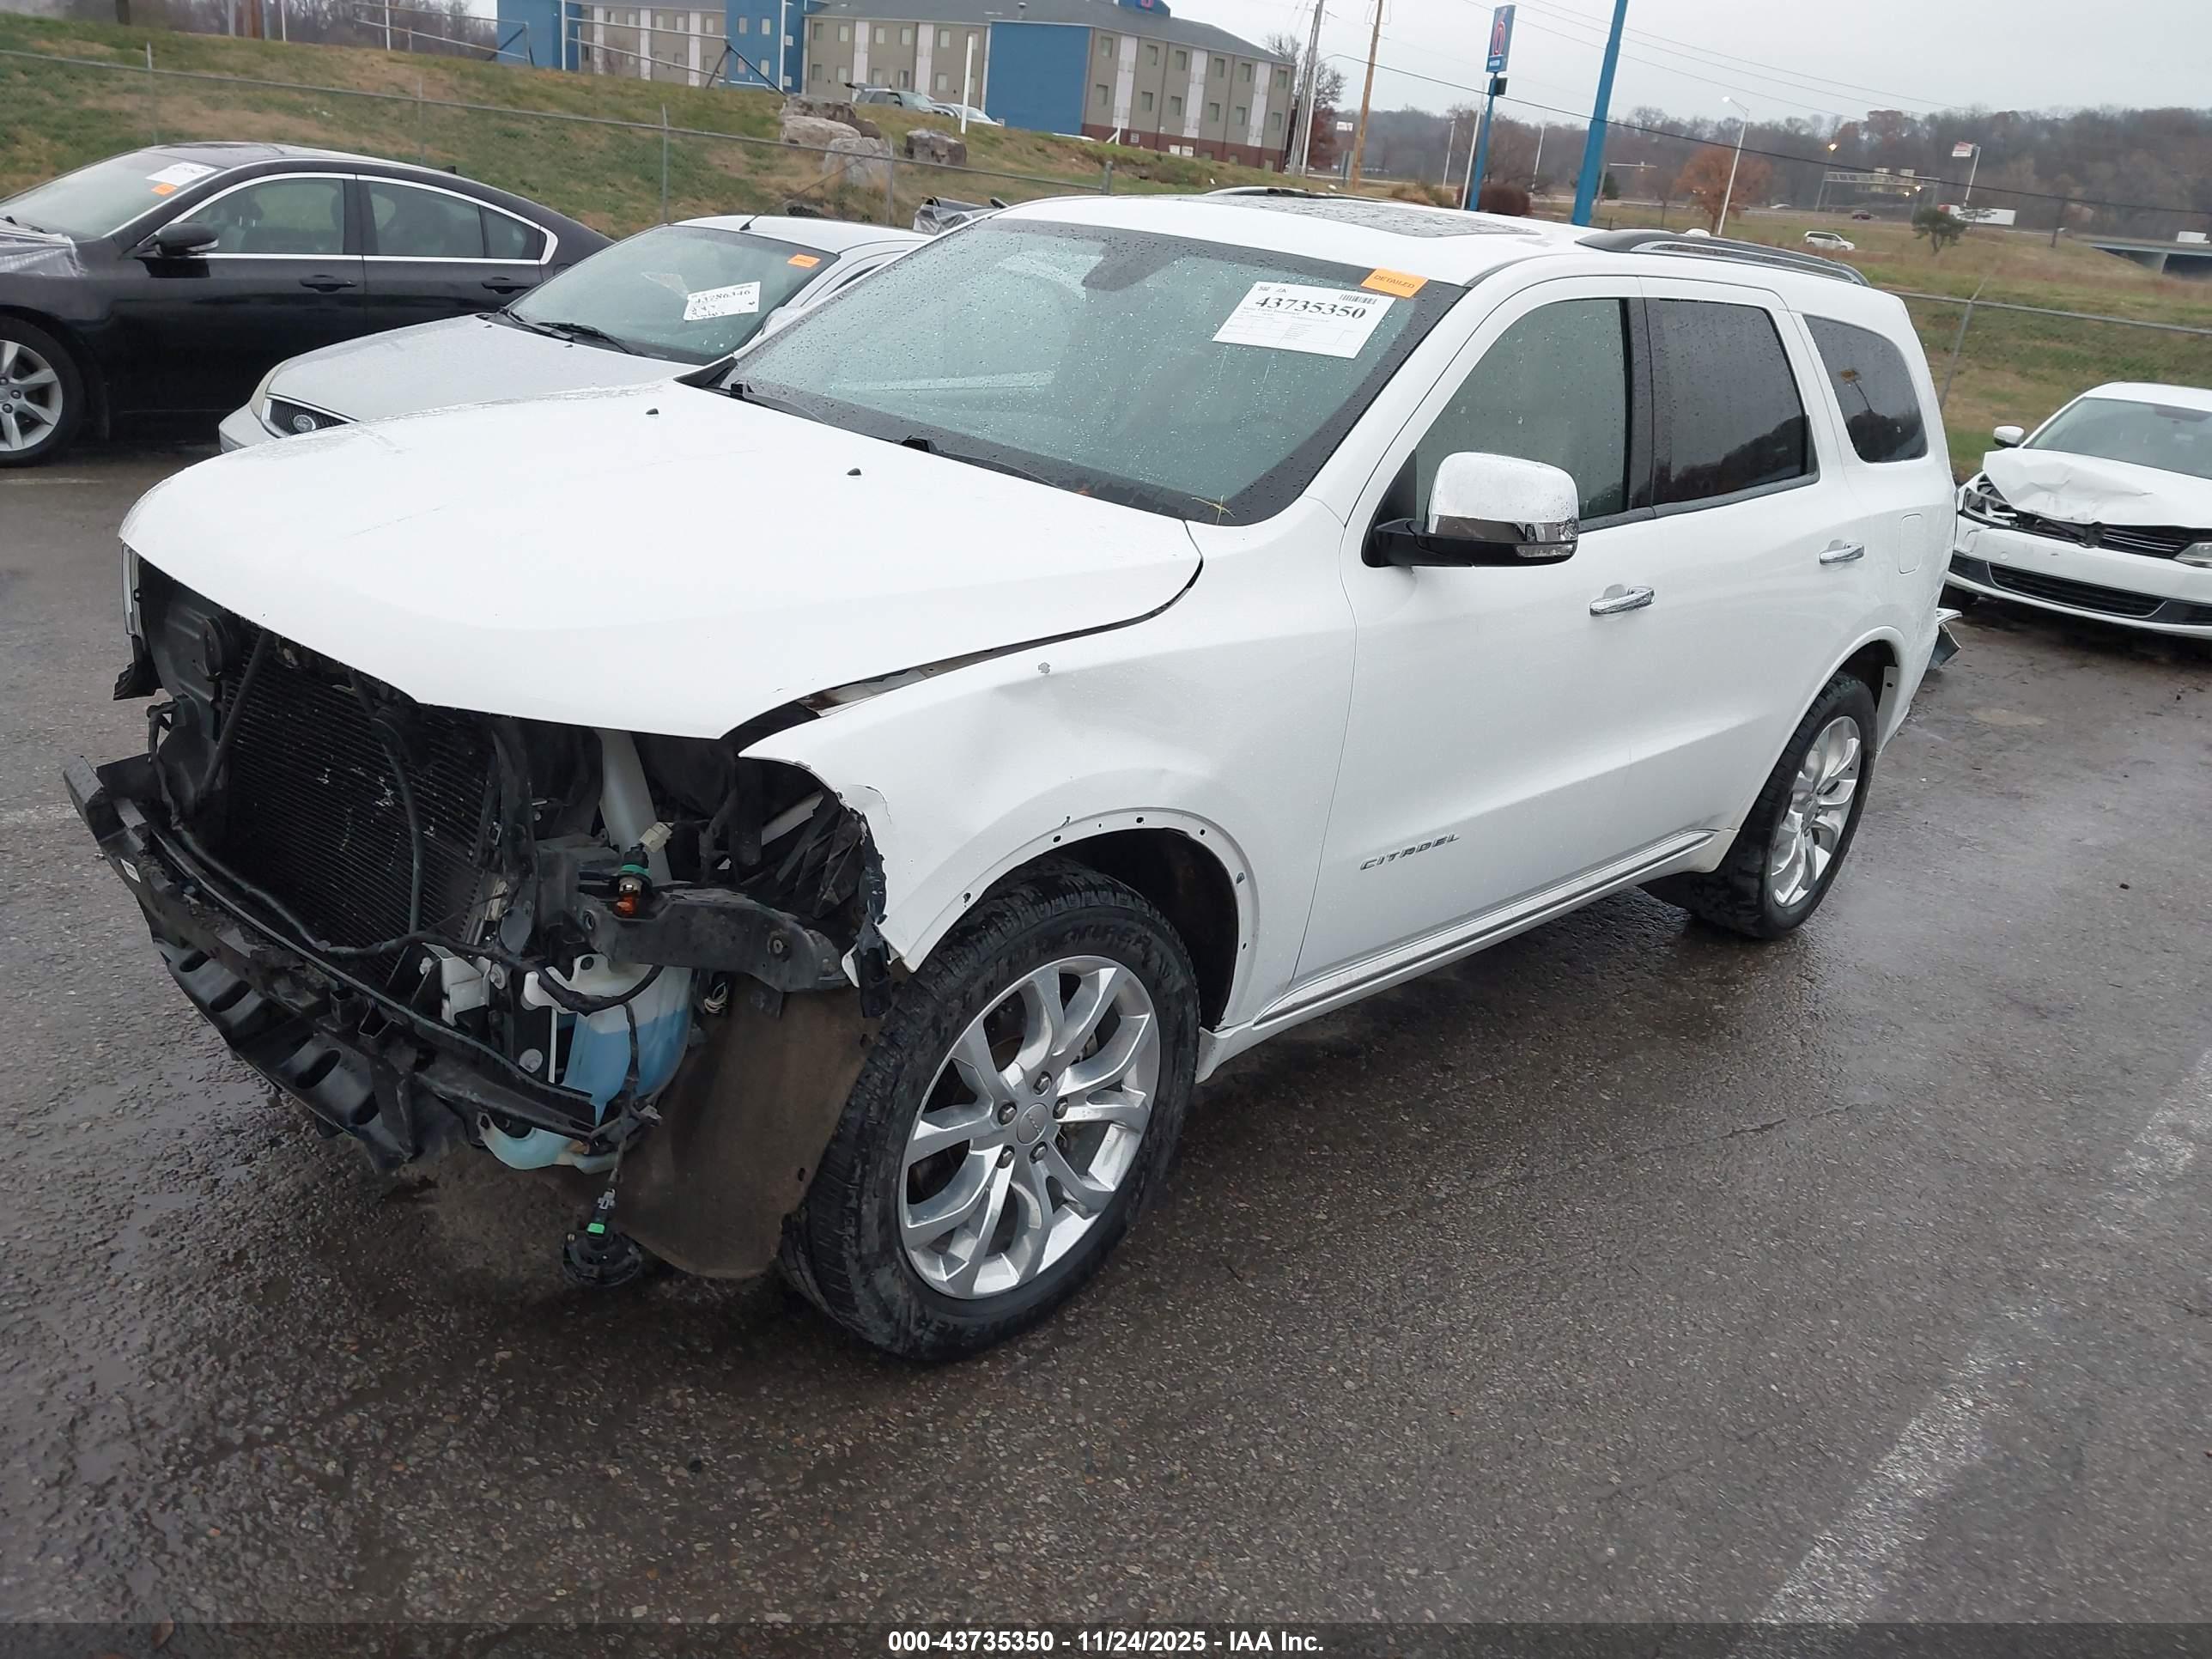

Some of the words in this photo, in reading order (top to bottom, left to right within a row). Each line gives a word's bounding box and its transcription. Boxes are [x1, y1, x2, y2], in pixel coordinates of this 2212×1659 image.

[1373, 274, 1415, 289] DETAILED
[1255, 296, 1366, 319] 43735350
[1359, 834, 1460, 871] CITADEL
